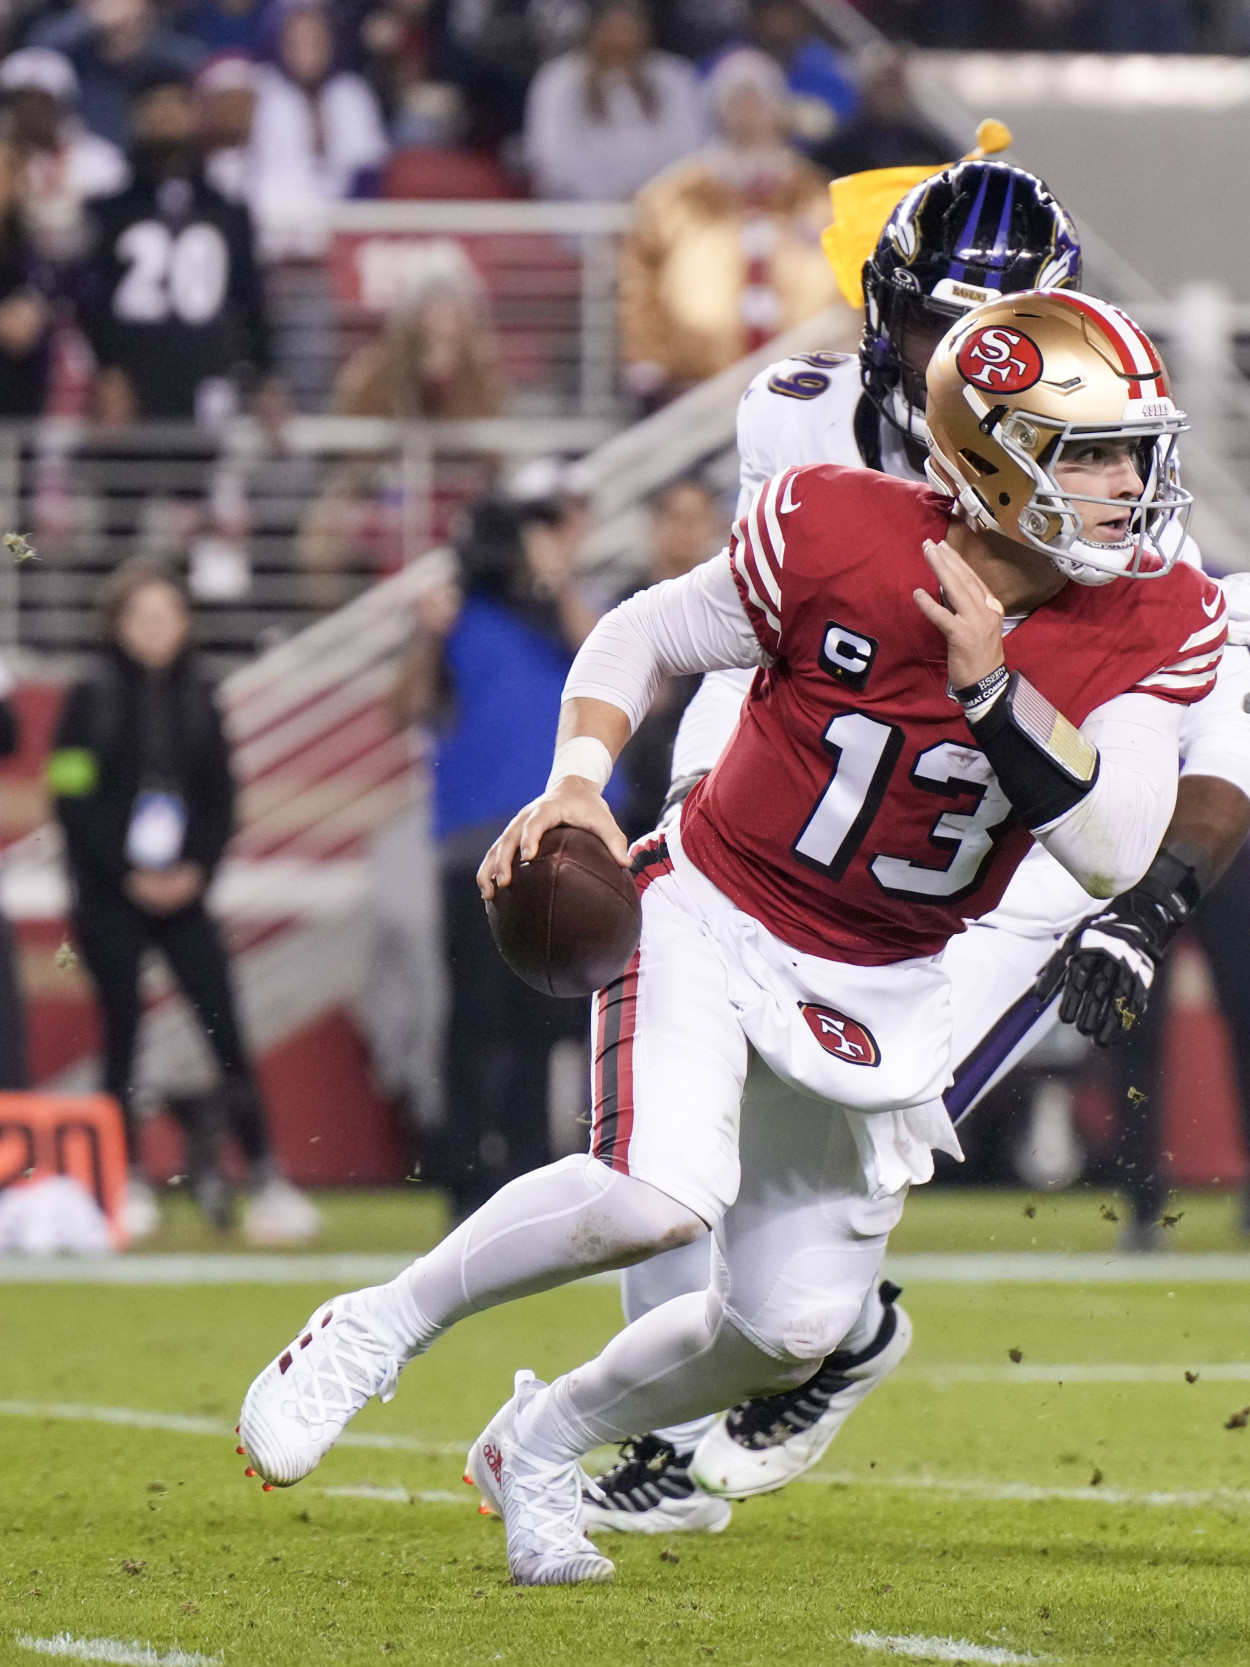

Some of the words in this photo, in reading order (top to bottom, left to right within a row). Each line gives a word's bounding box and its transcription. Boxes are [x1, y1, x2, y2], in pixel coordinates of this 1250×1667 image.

[112, 218, 231, 326] 20
[951, 284, 988, 302] RAVENS
[823, 626, 872, 674] C
[790, 709, 1014, 906] 13
